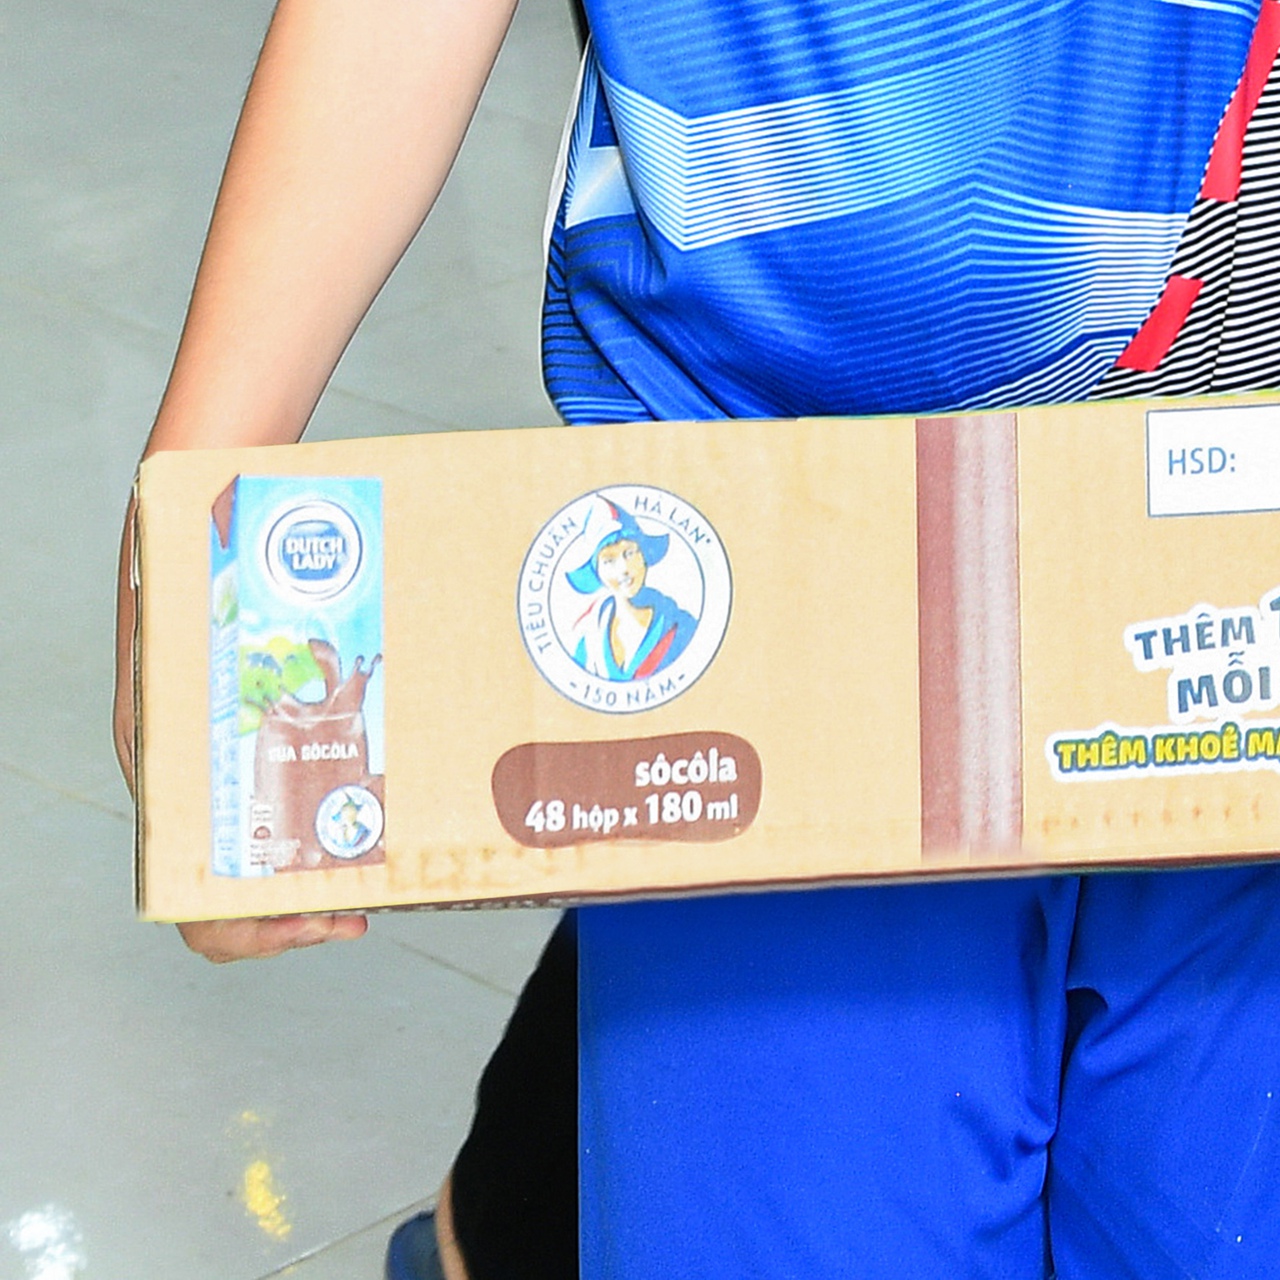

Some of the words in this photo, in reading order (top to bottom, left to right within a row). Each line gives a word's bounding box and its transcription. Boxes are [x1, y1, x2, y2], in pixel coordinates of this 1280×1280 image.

[1167, 445, 1237, 477] HSD:
[285, 537, 343, 555] DUTCH
[292, 553, 337, 571] LADY
[1134, 612, 1256, 661] THÊM
[1176, 650, 1272, 714] MỖI
[634, 746, 739, 788] sôcôla
[1057, 724, 1147, 771] THÊM
[524, 799, 567, 834] 48
[571, 803, 620, 835] hộp
[622, 806, 639, 828] x
[644, 789, 703, 825] 180
[706, 792, 739, 821] ml
